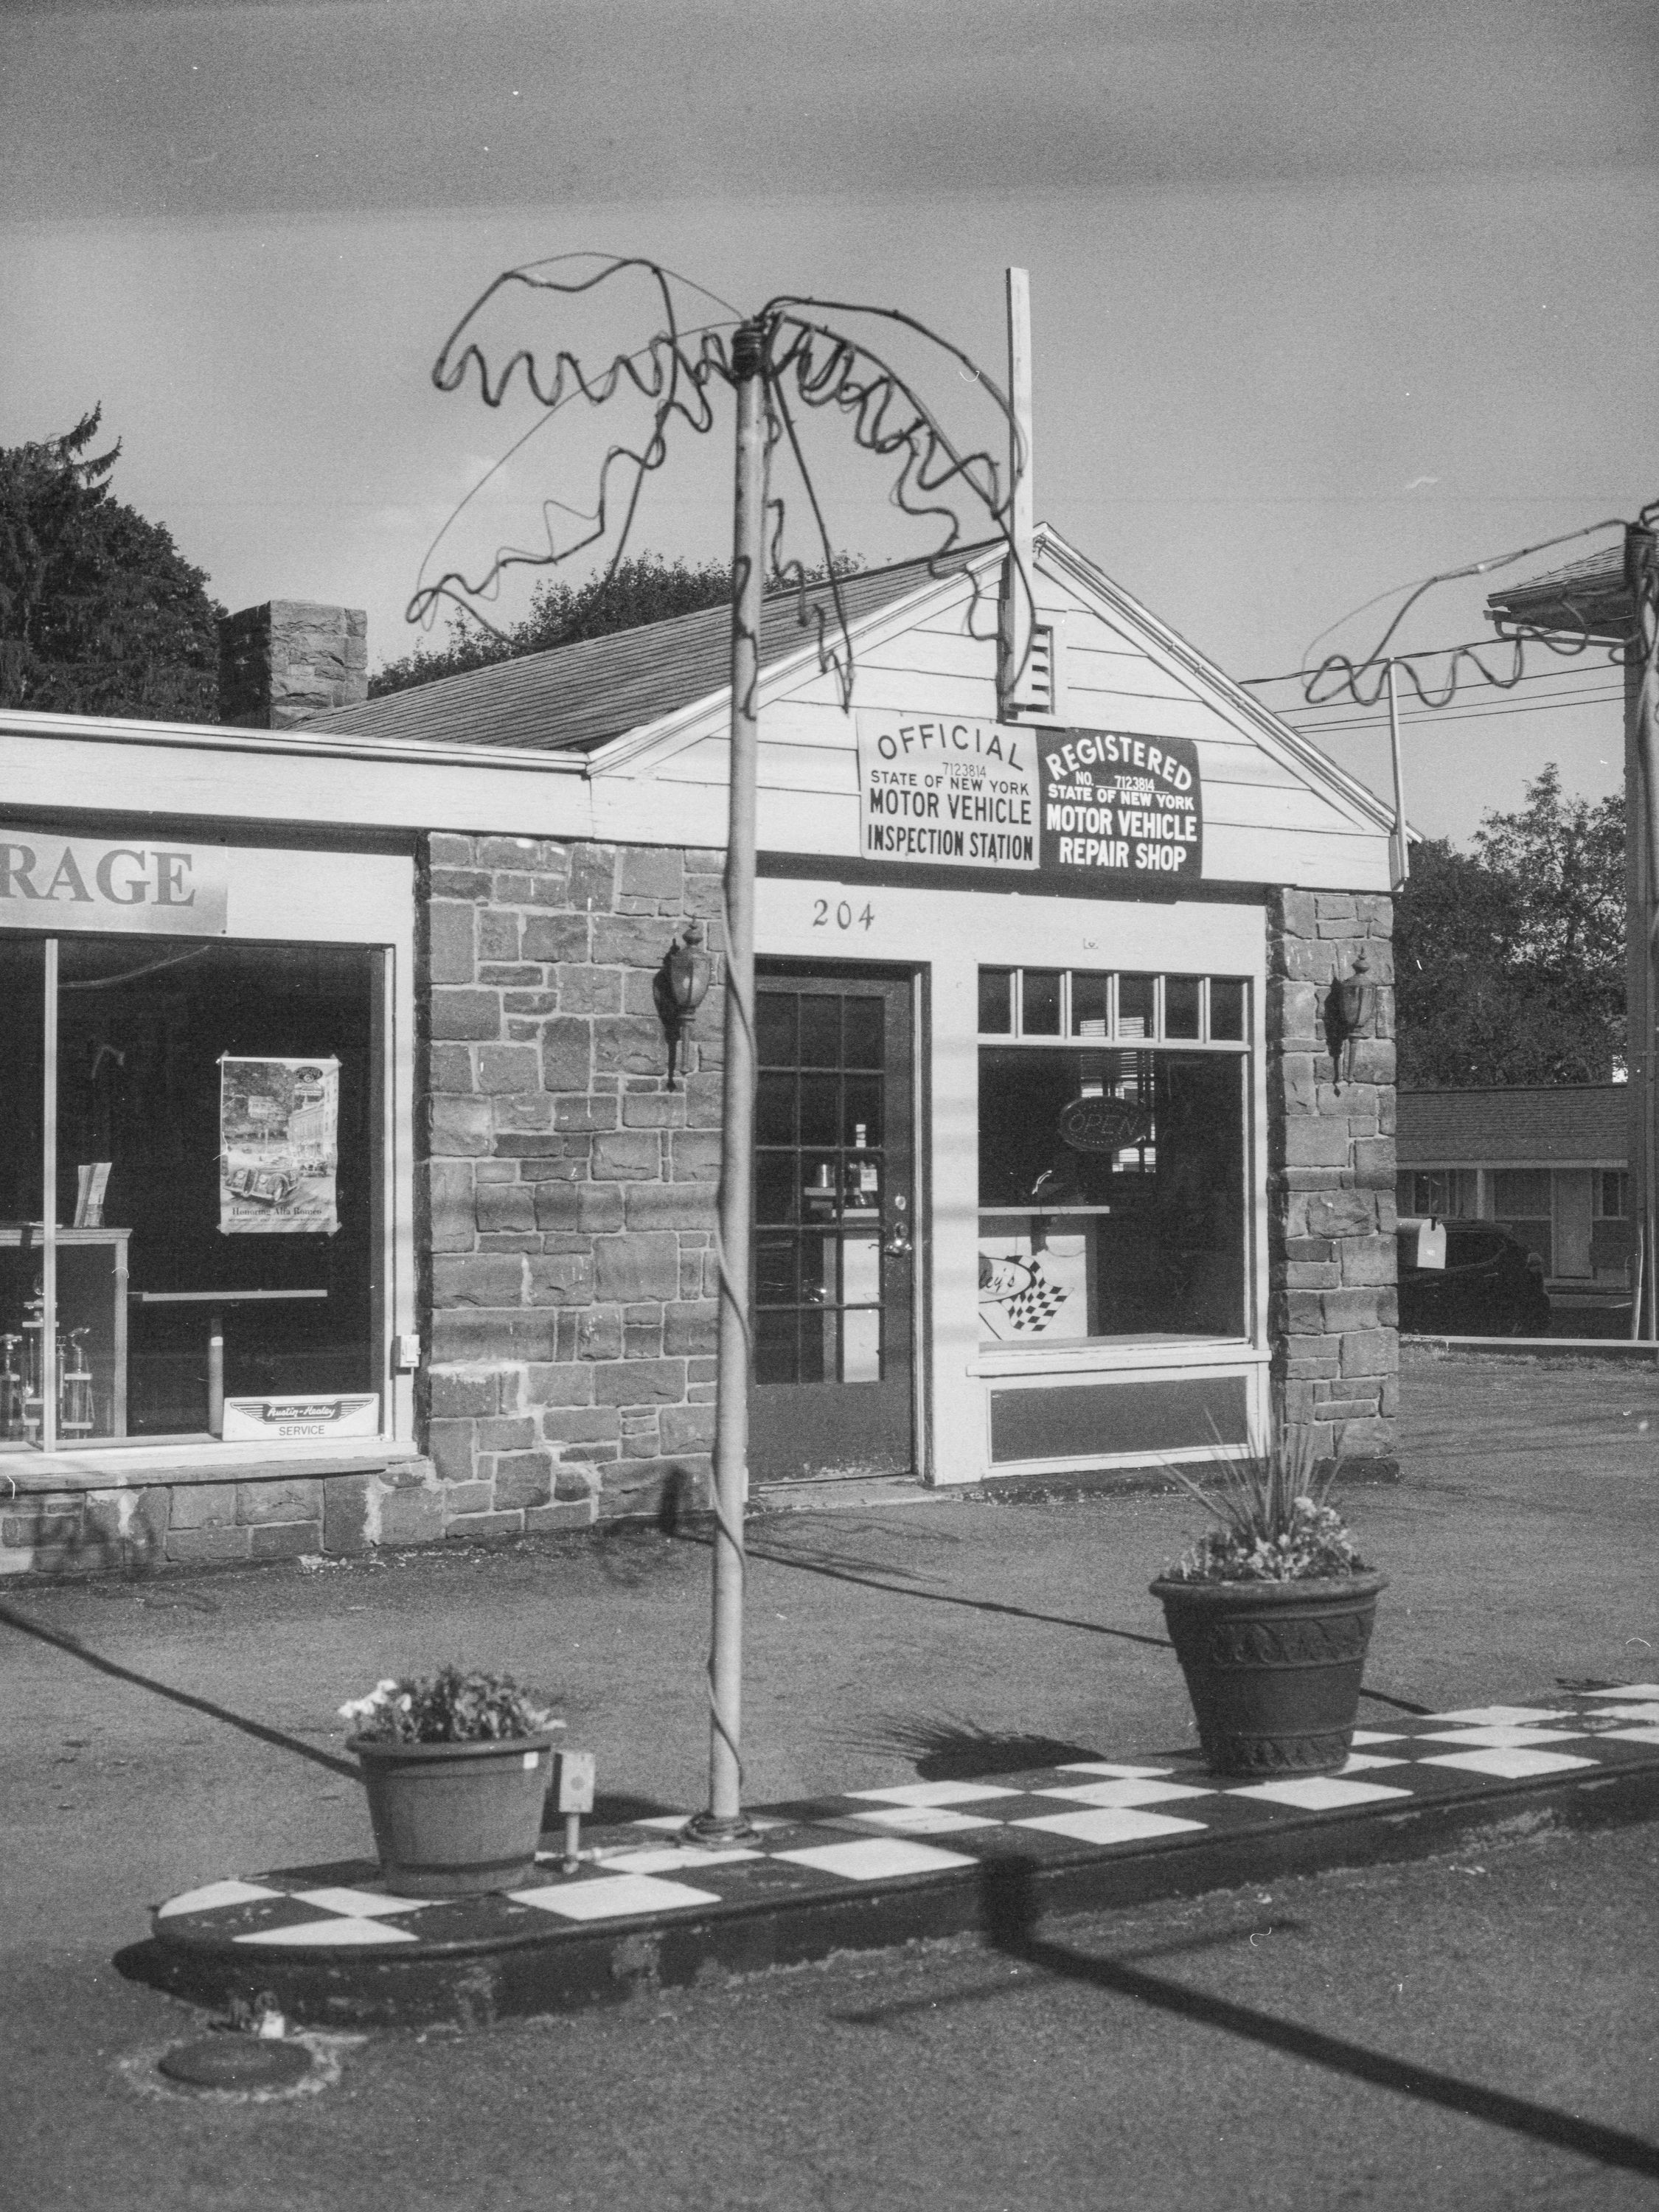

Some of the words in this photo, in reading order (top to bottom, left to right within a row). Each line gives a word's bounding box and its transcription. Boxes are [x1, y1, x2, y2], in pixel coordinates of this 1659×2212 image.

[877, 723, 1023, 772] OFFICIAL
[1046, 734, 1192, 790] REGISTERED
[871, 770, 918, 786] STATE
[924, 774, 944, 788] OF
[950, 777, 983, 792] NEW
[990, 780, 1029, 796] YORK
[942, 762, 987, 778] 7123814
[1075, 771, 1094, 786] NO.
[1114, 775, 1155, 792] 7123814
[870, 787, 939, 818] MOTOR
[947, 793, 1032, 825] VEHICLE
[1048, 784, 1093, 801] STATE
[1096, 788, 1117, 803] OF
[1120, 790, 1152, 807] NEW
[1155, 794, 1194, 810] YORK
[1046, 803, 1113, 835] MOTOR
[1117, 810, 1197, 841] VEHICLE
[868, 824, 964, 856] INSPECTION
[970, 832, 1033, 861] STATION
[1060, 836, 1130, 868] REPAIR
[1135, 843, 1187, 872] SHOP
[0, 843, 196, 908] RAGE
[813, 899, 875, 931] 204
[1068, 1113, 1140, 1135] OPEN
[293, 1206, 322, 1216] Romeo
[267, 1405, 335, 1419] Austin-Healey
[279, 1425, 325, 1436] SERVICE
